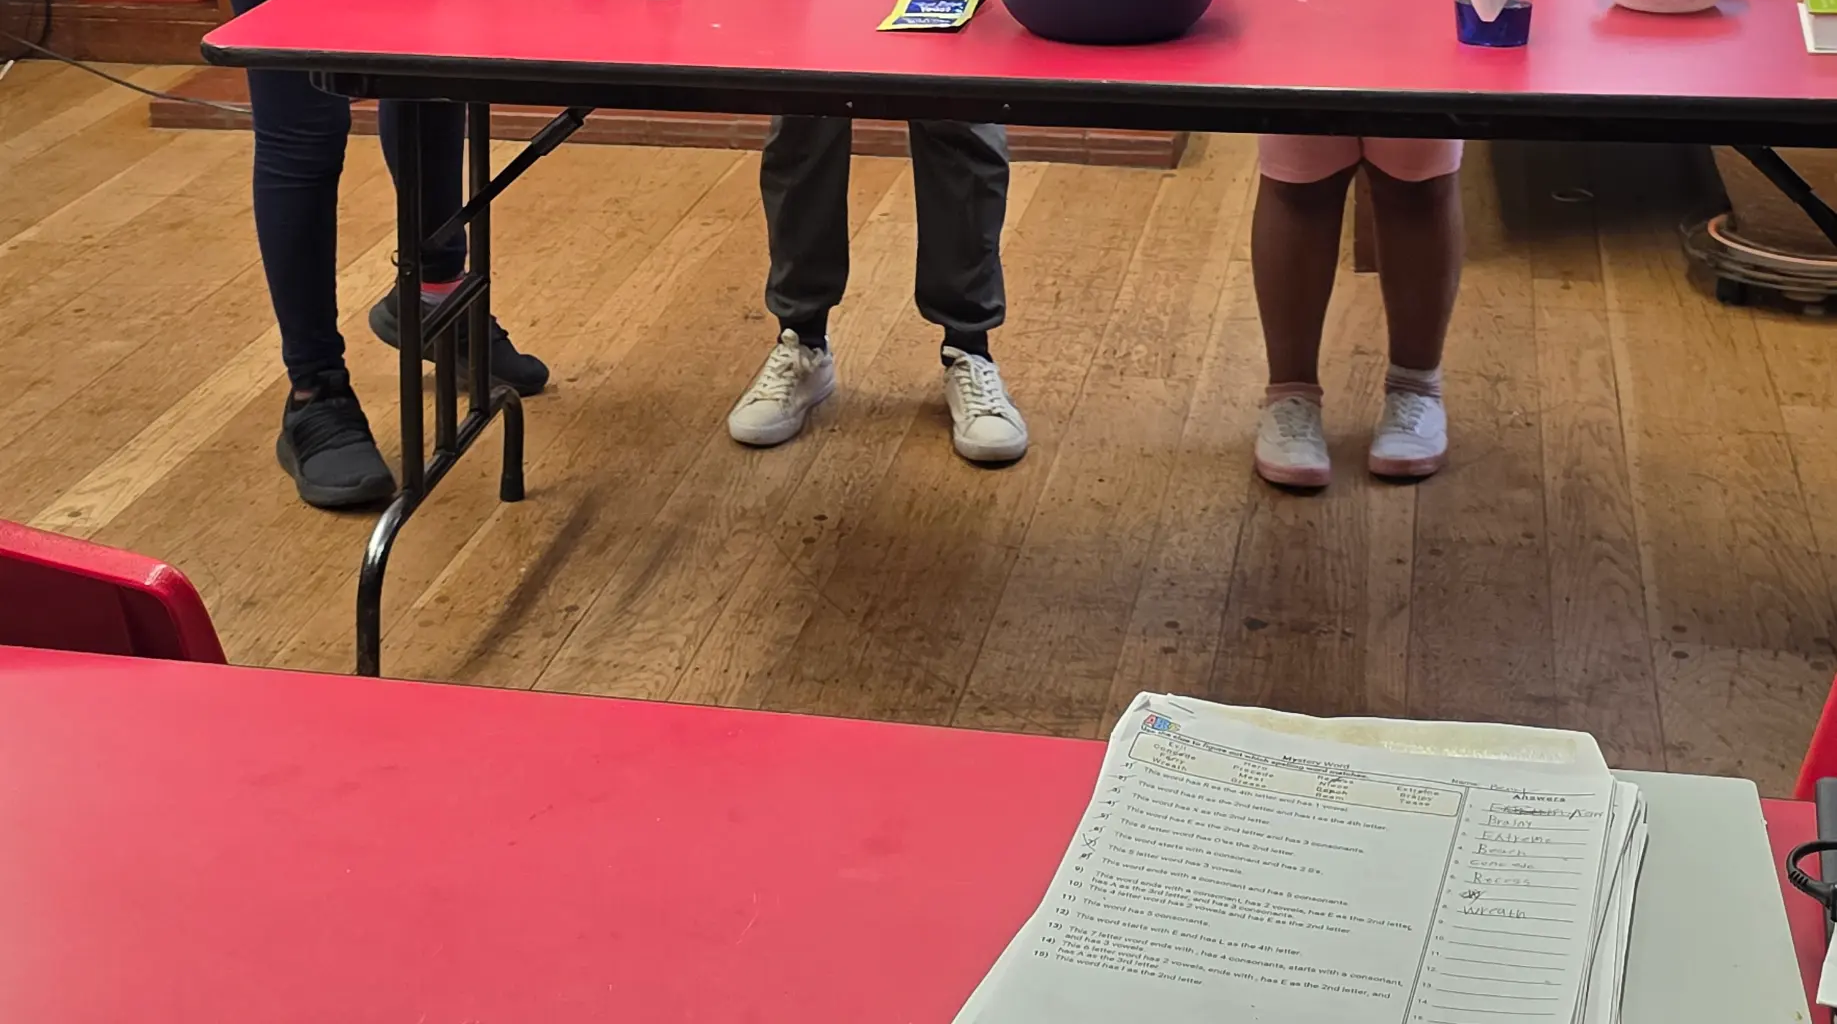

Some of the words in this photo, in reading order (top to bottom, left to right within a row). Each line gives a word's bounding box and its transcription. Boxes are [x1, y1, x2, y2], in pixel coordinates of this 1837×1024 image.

[1512, 794, 1566, 803] Answers
[1083, 897, 1101, 907] This
[1103, 903, 1127, 912] word
[1089, 883, 1107, 893] This
[1117, 890, 1141, 899] letter
[1142, 896, 1166, 904] word
[1194, 905, 1226, 915] vowels
[1076, 911, 1094, 921] This
[1096, 917, 1120, 925] word
[1121, 921, 1148, 930] starts
[1062, 939, 1081, 948] This
[1091, 945, 1116, 955] letter
[1117, 951, 1142, 959] word
[1069, 925, 1087, 935] This
[1098, 931, 1122, 940] letter
[1124, 937, 1148, 945] word
[1288, 965, 1316, 973] starts
[1055, 953, 1074, 962] This
[1076, 959, 1101, 967] word
